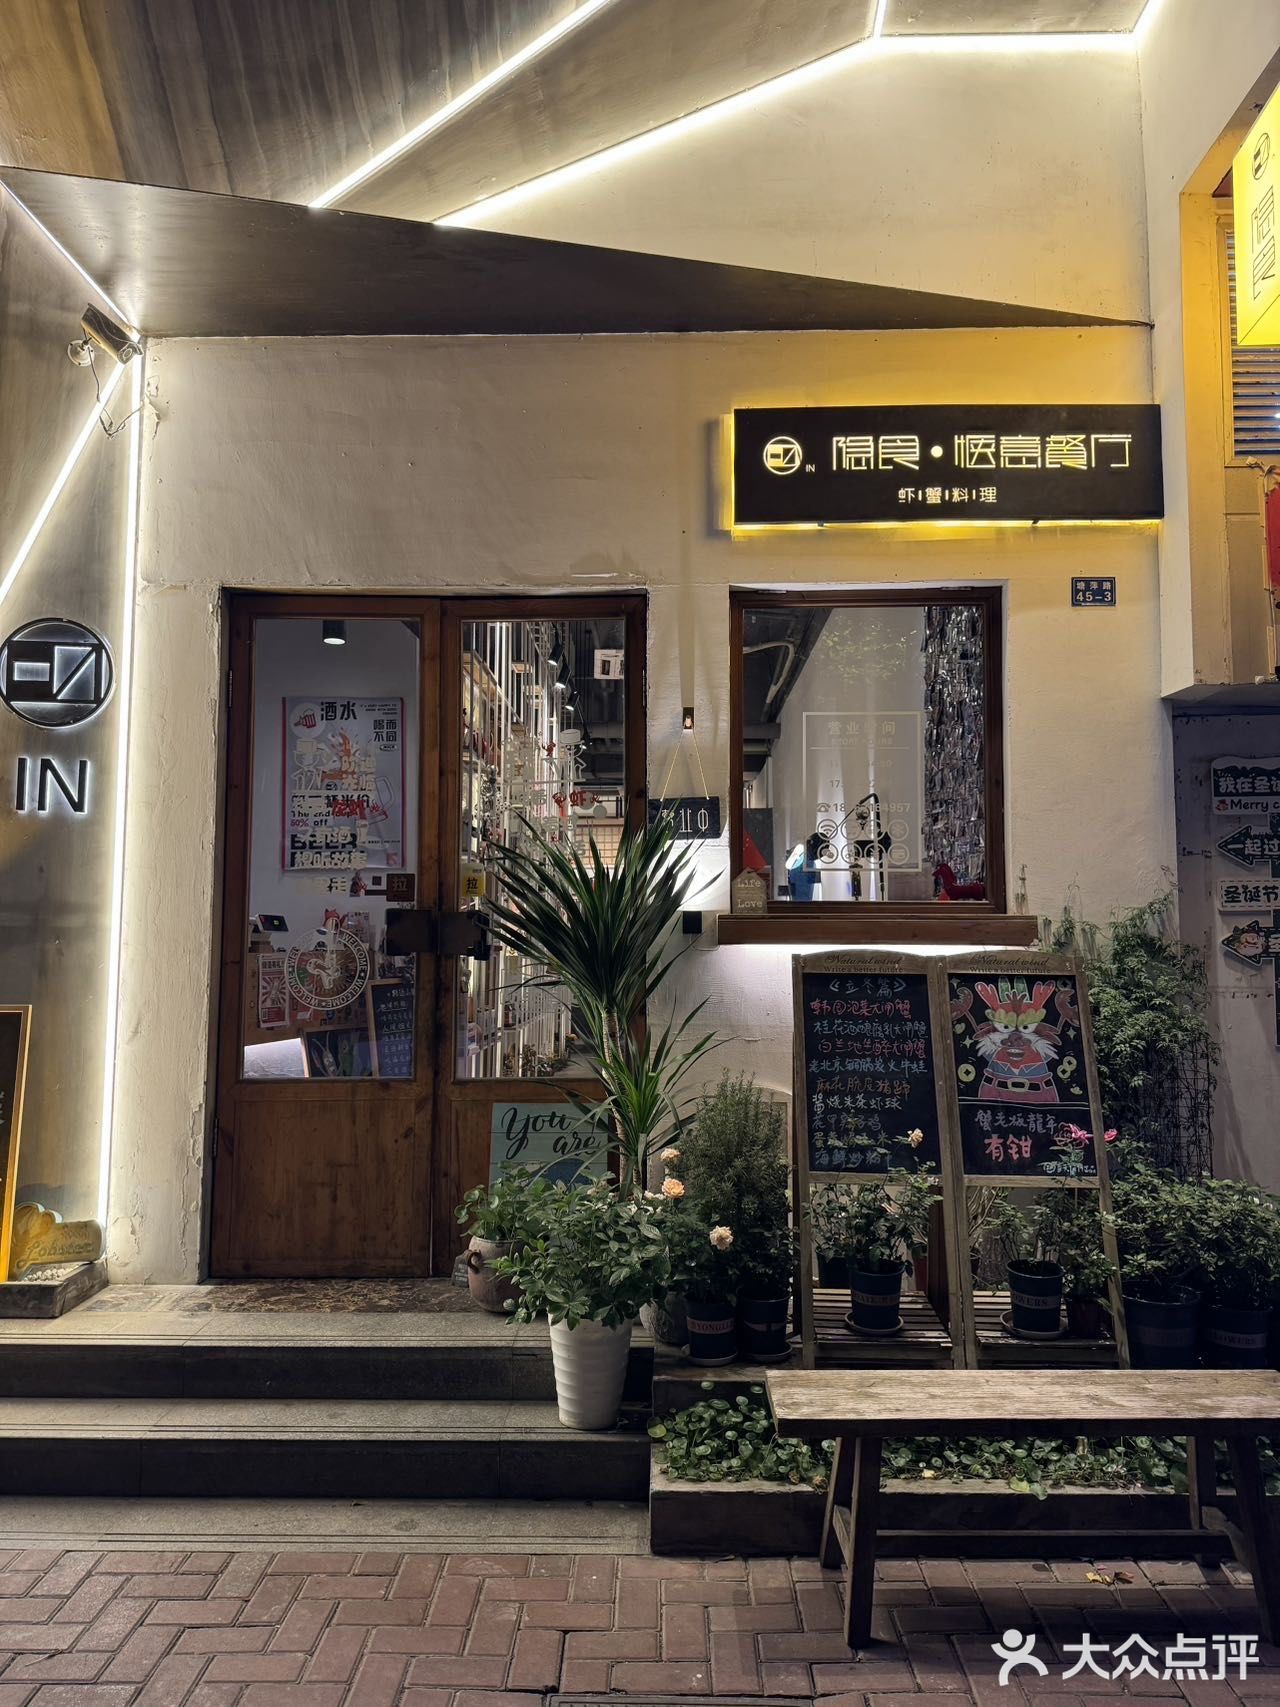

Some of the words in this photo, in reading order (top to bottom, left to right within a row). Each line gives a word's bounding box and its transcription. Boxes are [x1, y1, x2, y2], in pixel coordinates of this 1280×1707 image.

[805, 463, 816, 473] IN
[1076, 591, 1111, 602] 45-3
[320, 700, 357, 720] 酒水
[15, 757, 89, 814] IN
[1230, 799, 1269, 812] Merry
[314, 818, 329, 826] off
[737, 878, 761, 888] Life
[737, 899, 763, 908] Love
[1224, 885, 1279, 903] 圣诞节
[341, 933, 368, 971] WELCOME
[288, 972, 319, 1007] WELCOME
[326, 975, 366, 1008] WELCOME
[501, 1107, 572, 1160] You
[552, 1131, 601, 1156] are
[983, 1134, 1033, 1162] 有钳
